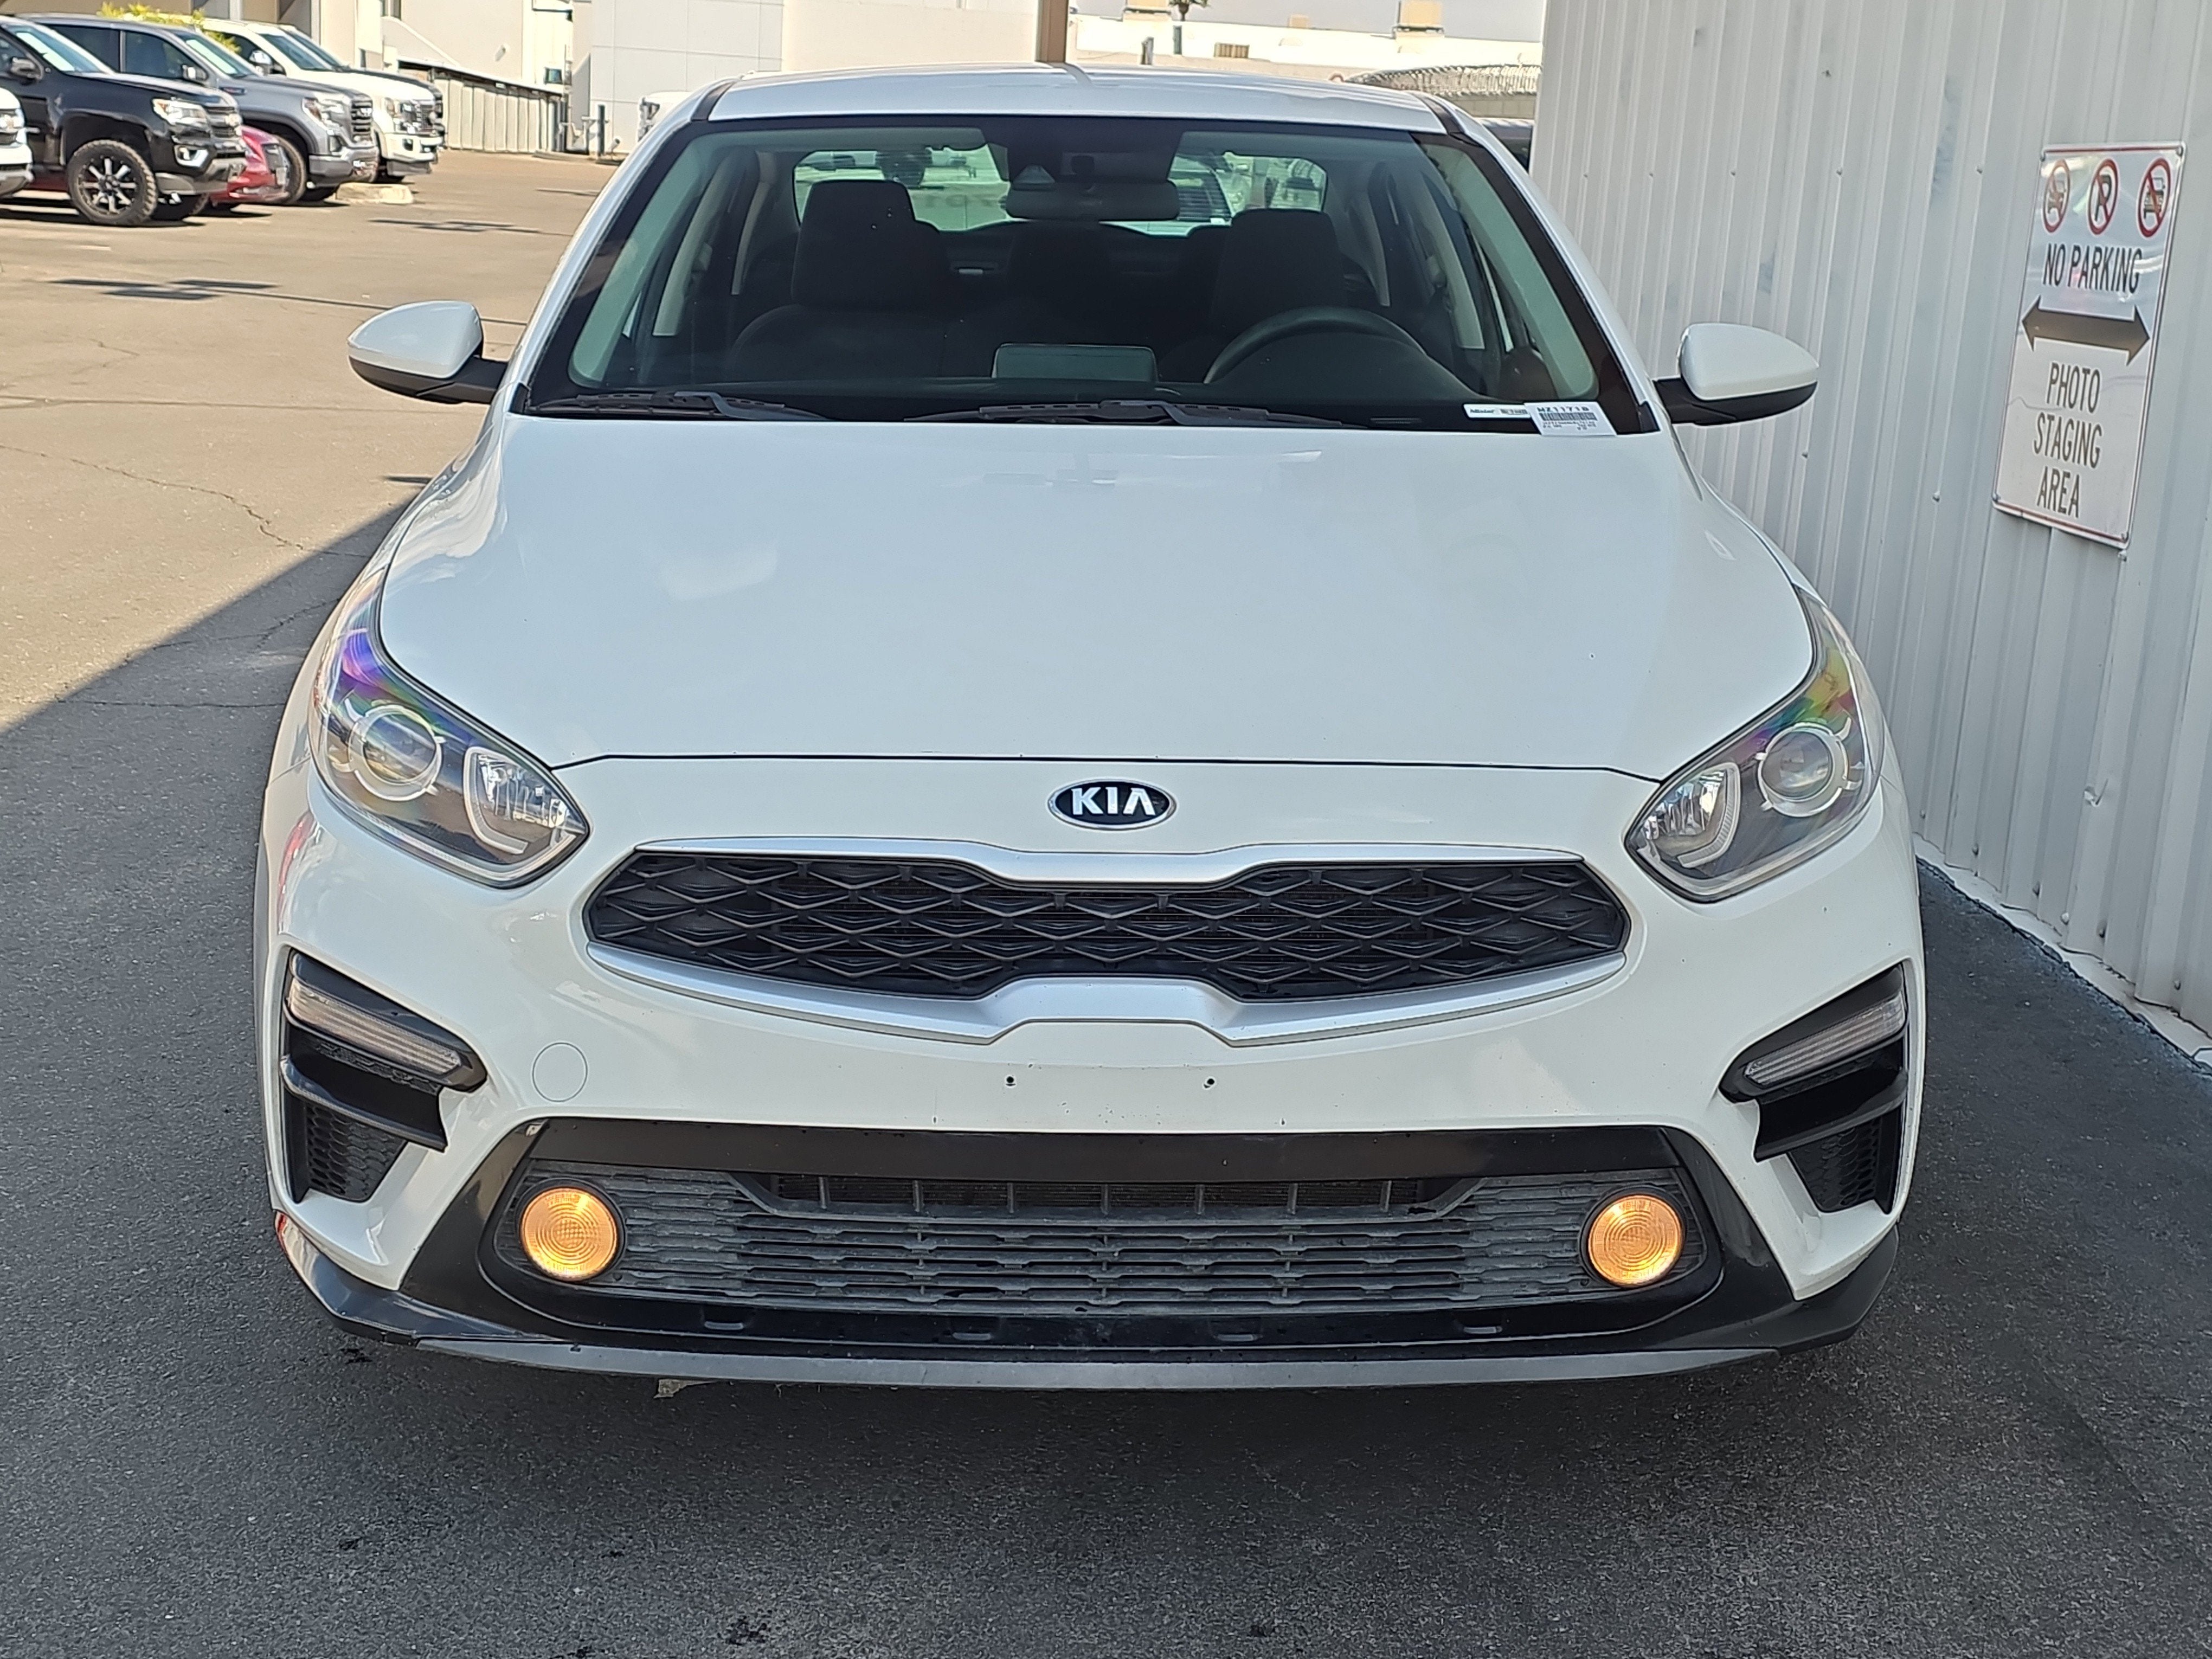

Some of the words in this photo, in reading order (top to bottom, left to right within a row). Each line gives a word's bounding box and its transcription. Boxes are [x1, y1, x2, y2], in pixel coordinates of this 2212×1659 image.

[2042, 243, 2066, 287] NO
[2067, 245, 2142, 294] PARKING
[2046, 362, 2100, 414] PHOTO
[2034, 411, 2102, 469] STAGING
[2036, 465, 2080, 518] AREA
[1071, 786, 1156, 815] KIA
